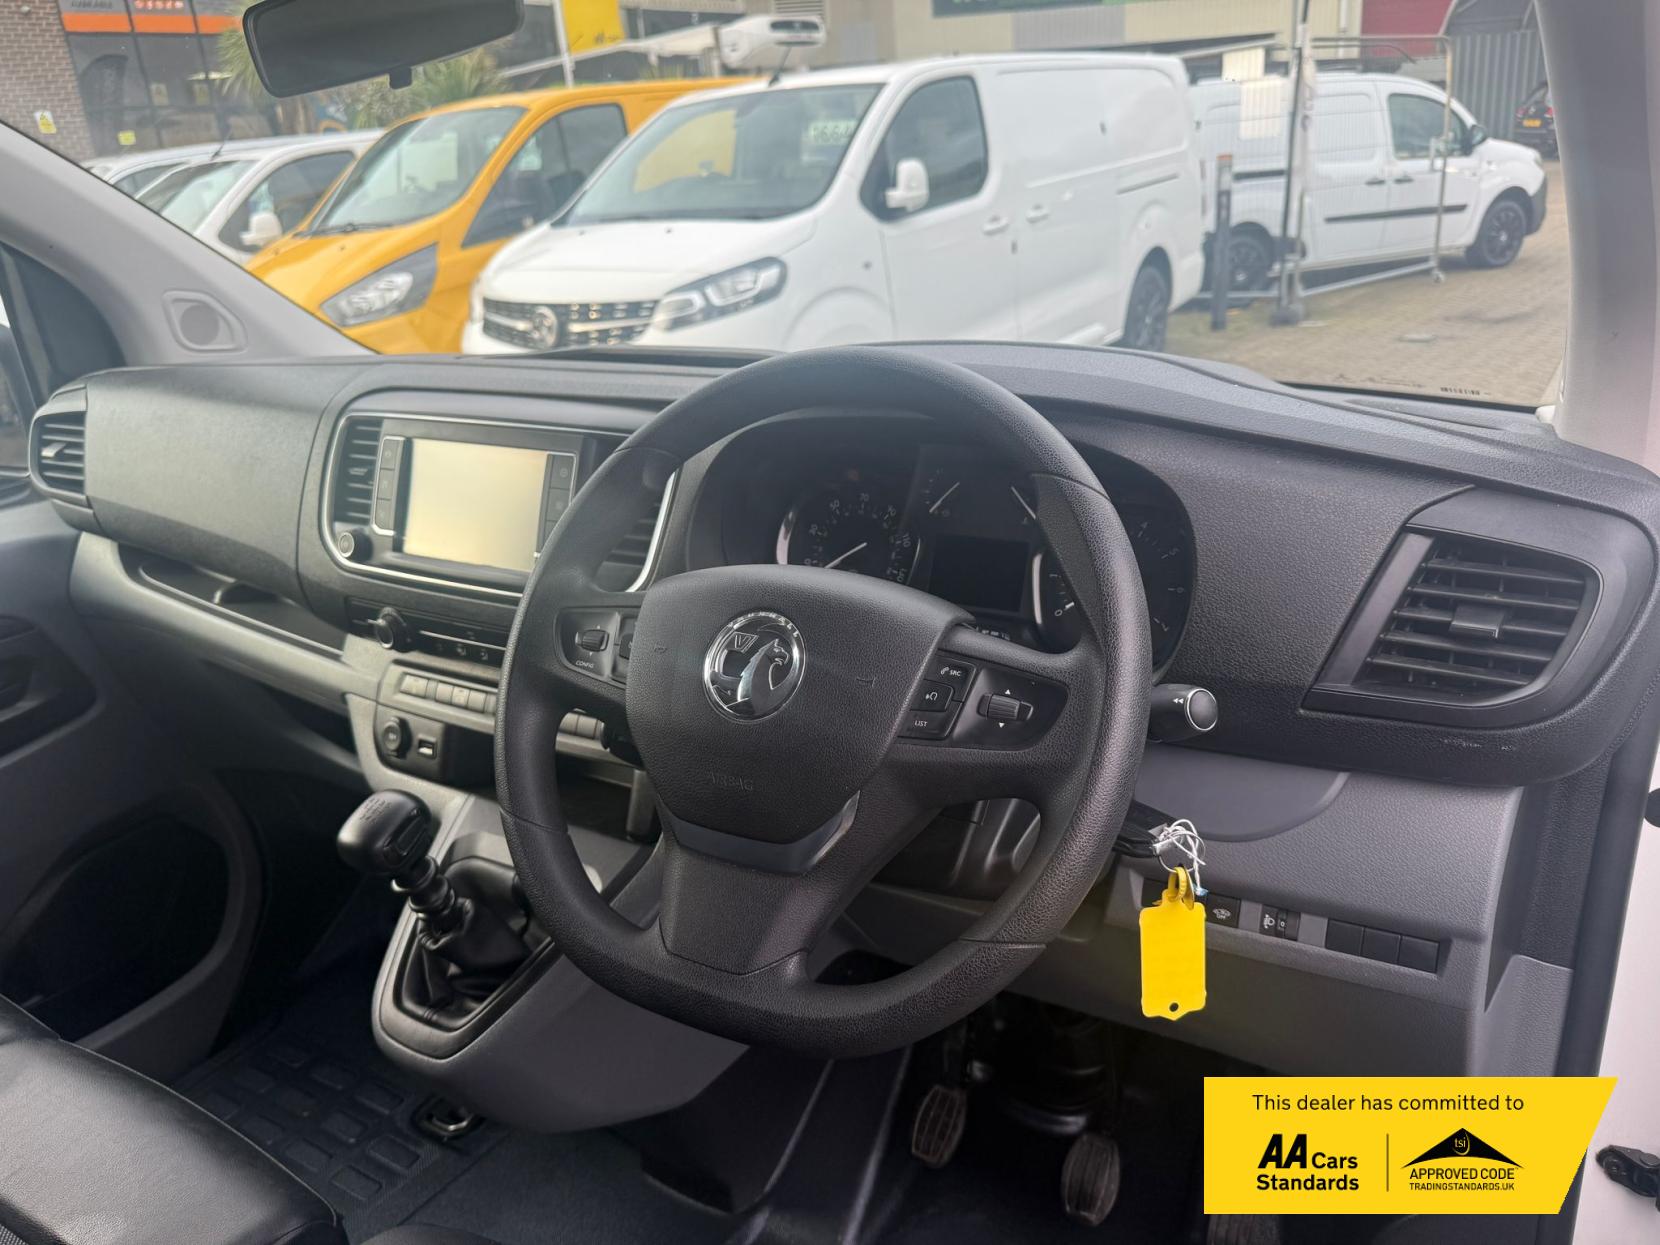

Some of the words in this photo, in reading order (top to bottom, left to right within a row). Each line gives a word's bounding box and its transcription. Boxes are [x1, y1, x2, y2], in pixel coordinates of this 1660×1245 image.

[576, 660, 594, 668] CONFIG
[950, 669, 962, 677] SRC
[914, 719, 928, 727] LIST
